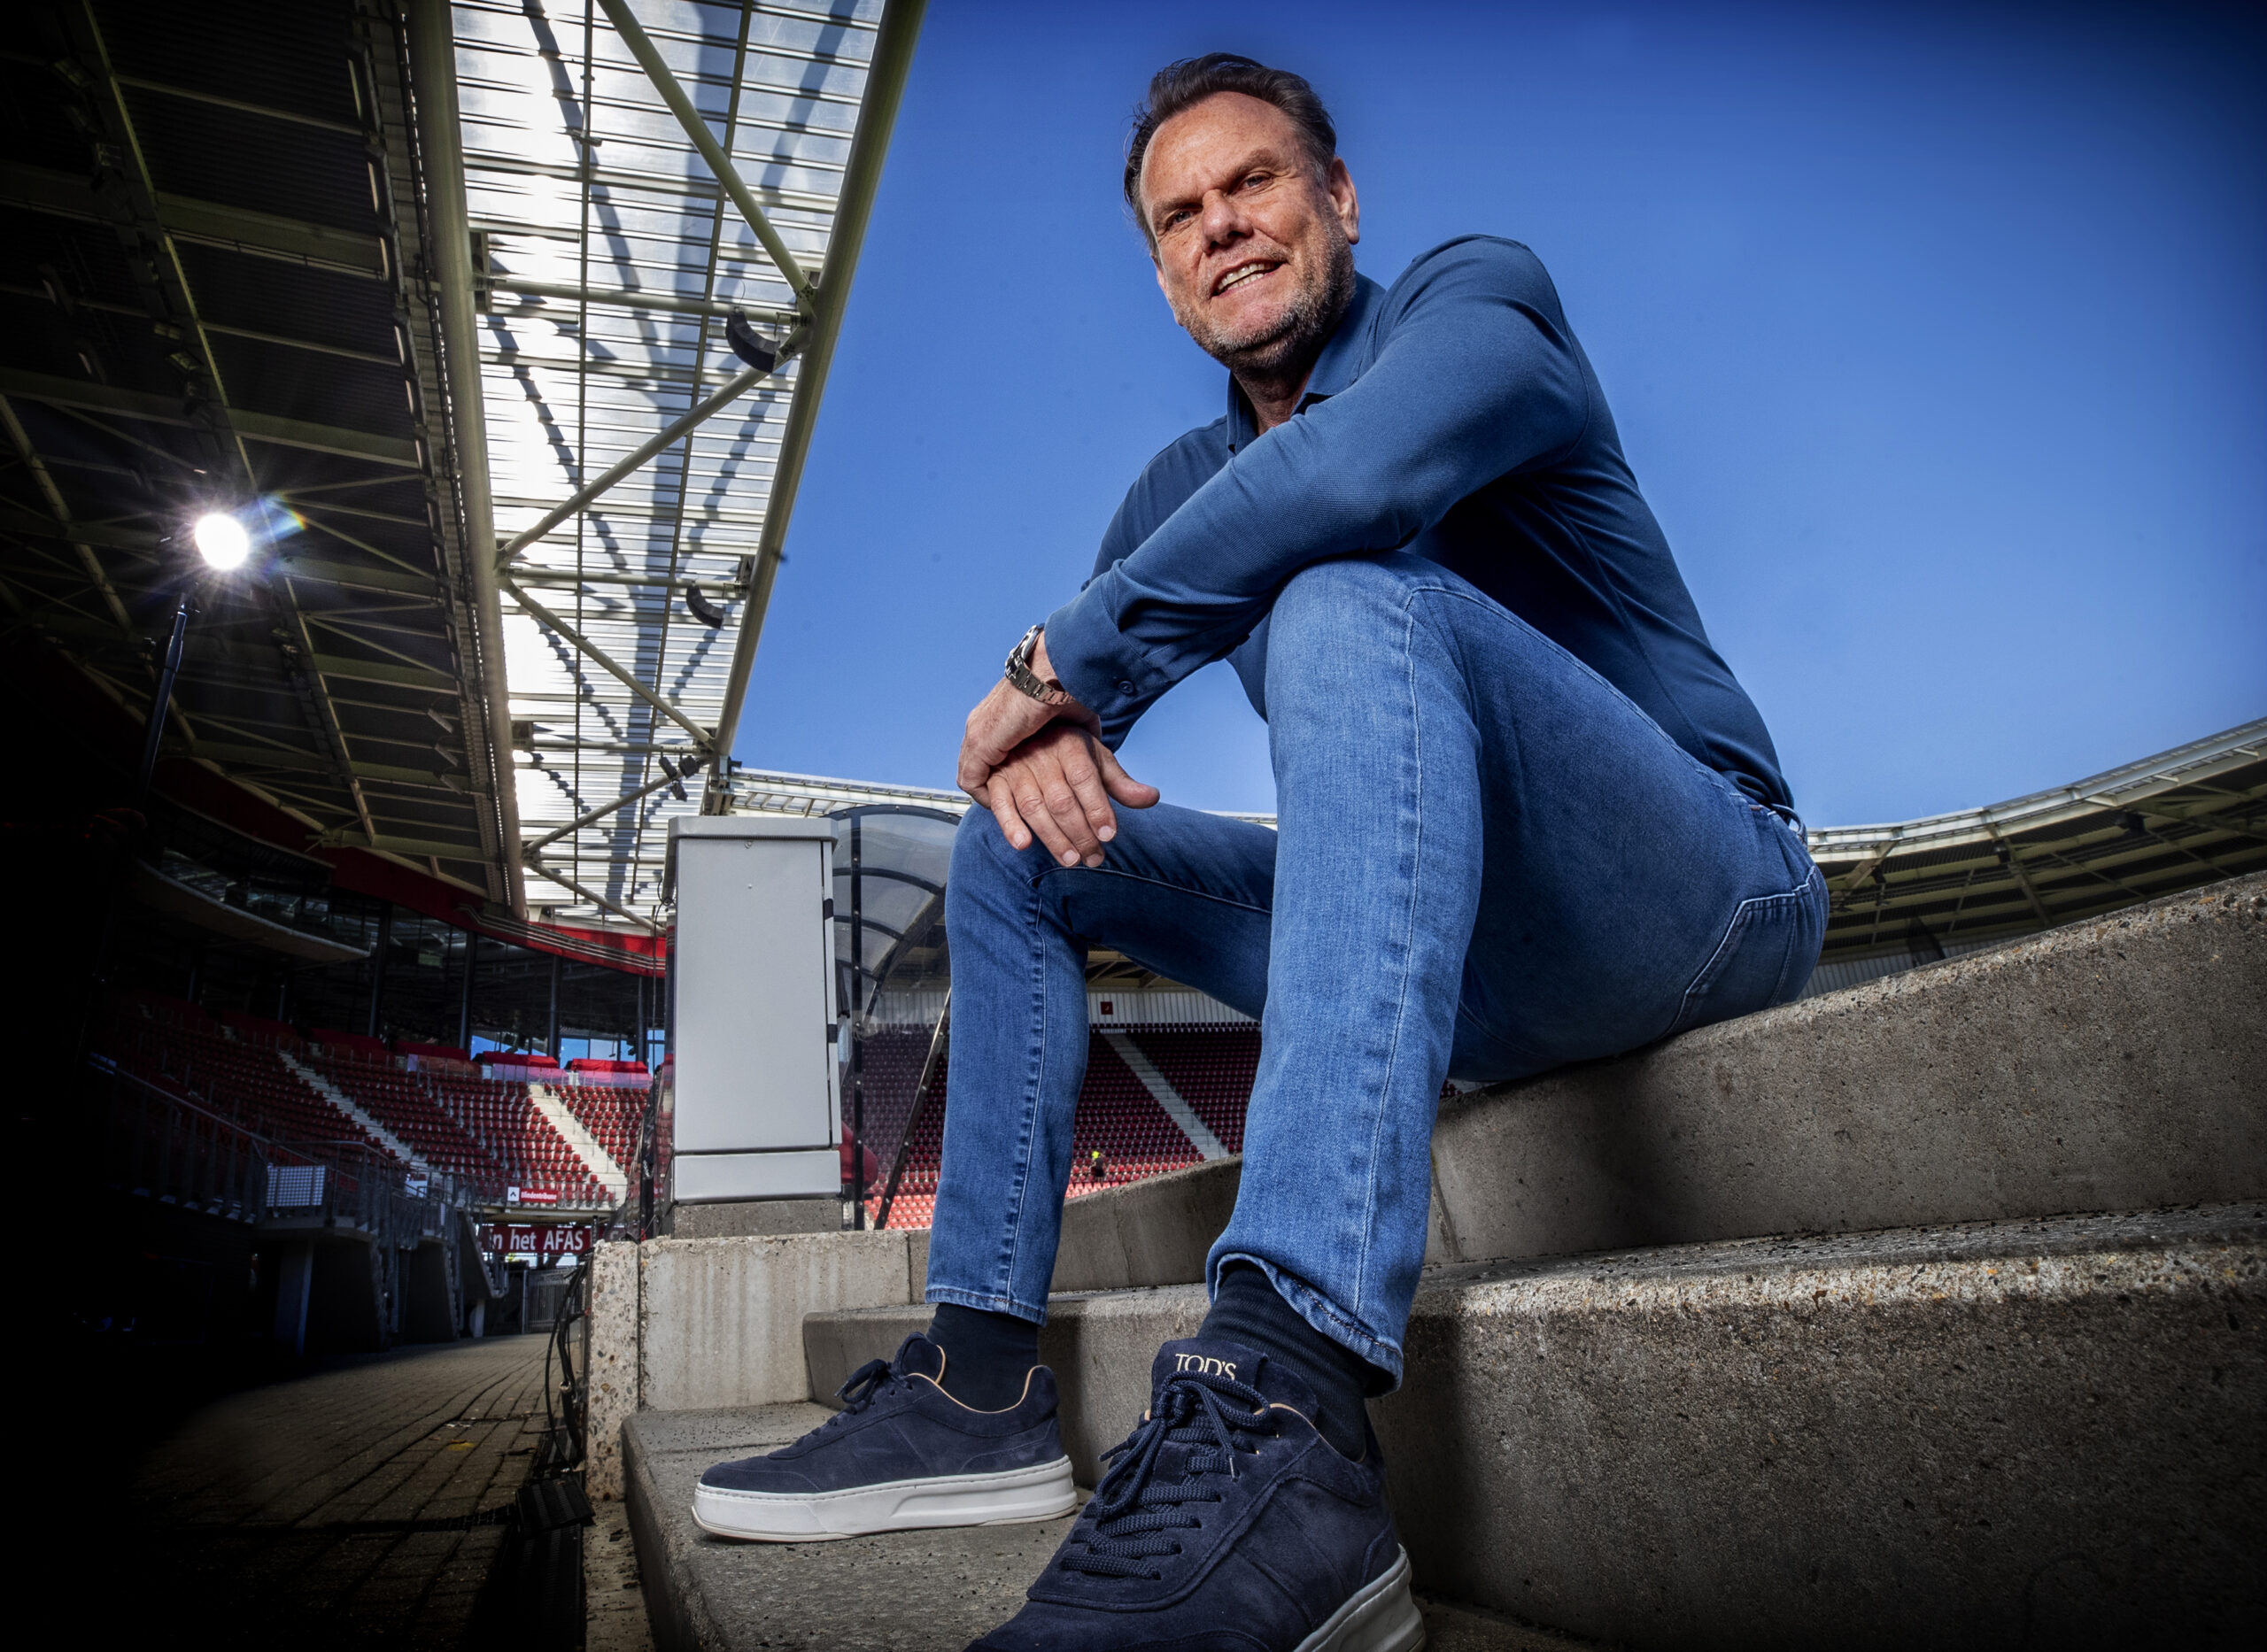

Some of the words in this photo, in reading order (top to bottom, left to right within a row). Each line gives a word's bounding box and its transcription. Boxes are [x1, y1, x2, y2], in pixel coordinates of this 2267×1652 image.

[510, 1228, 536, 1250] het
[543, 1230, 584, 1250] AFAS
[1175, 1354, 1237, 1381] TOD'S
